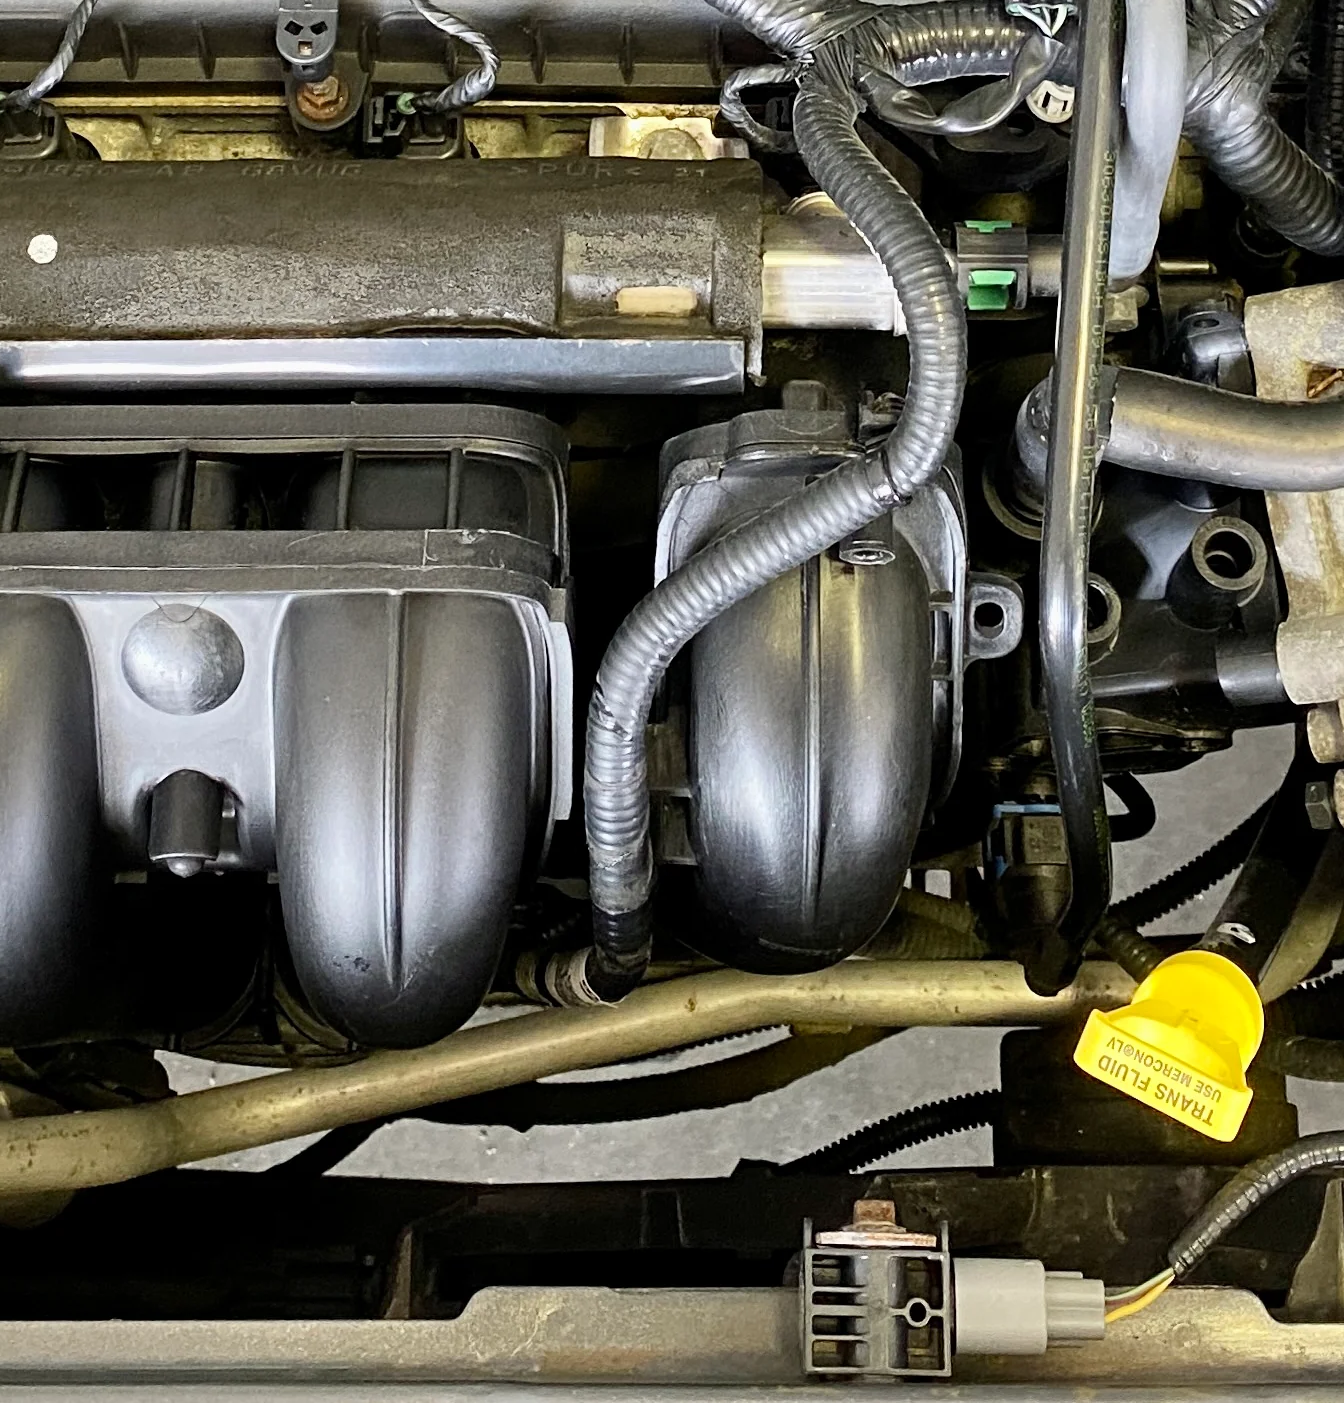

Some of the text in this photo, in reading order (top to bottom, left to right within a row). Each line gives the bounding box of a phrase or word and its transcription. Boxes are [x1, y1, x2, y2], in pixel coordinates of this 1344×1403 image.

[1098, 1054, 1216, 1128] TRANS FLUID
[1193, 1079, 1223, 1104] USE
